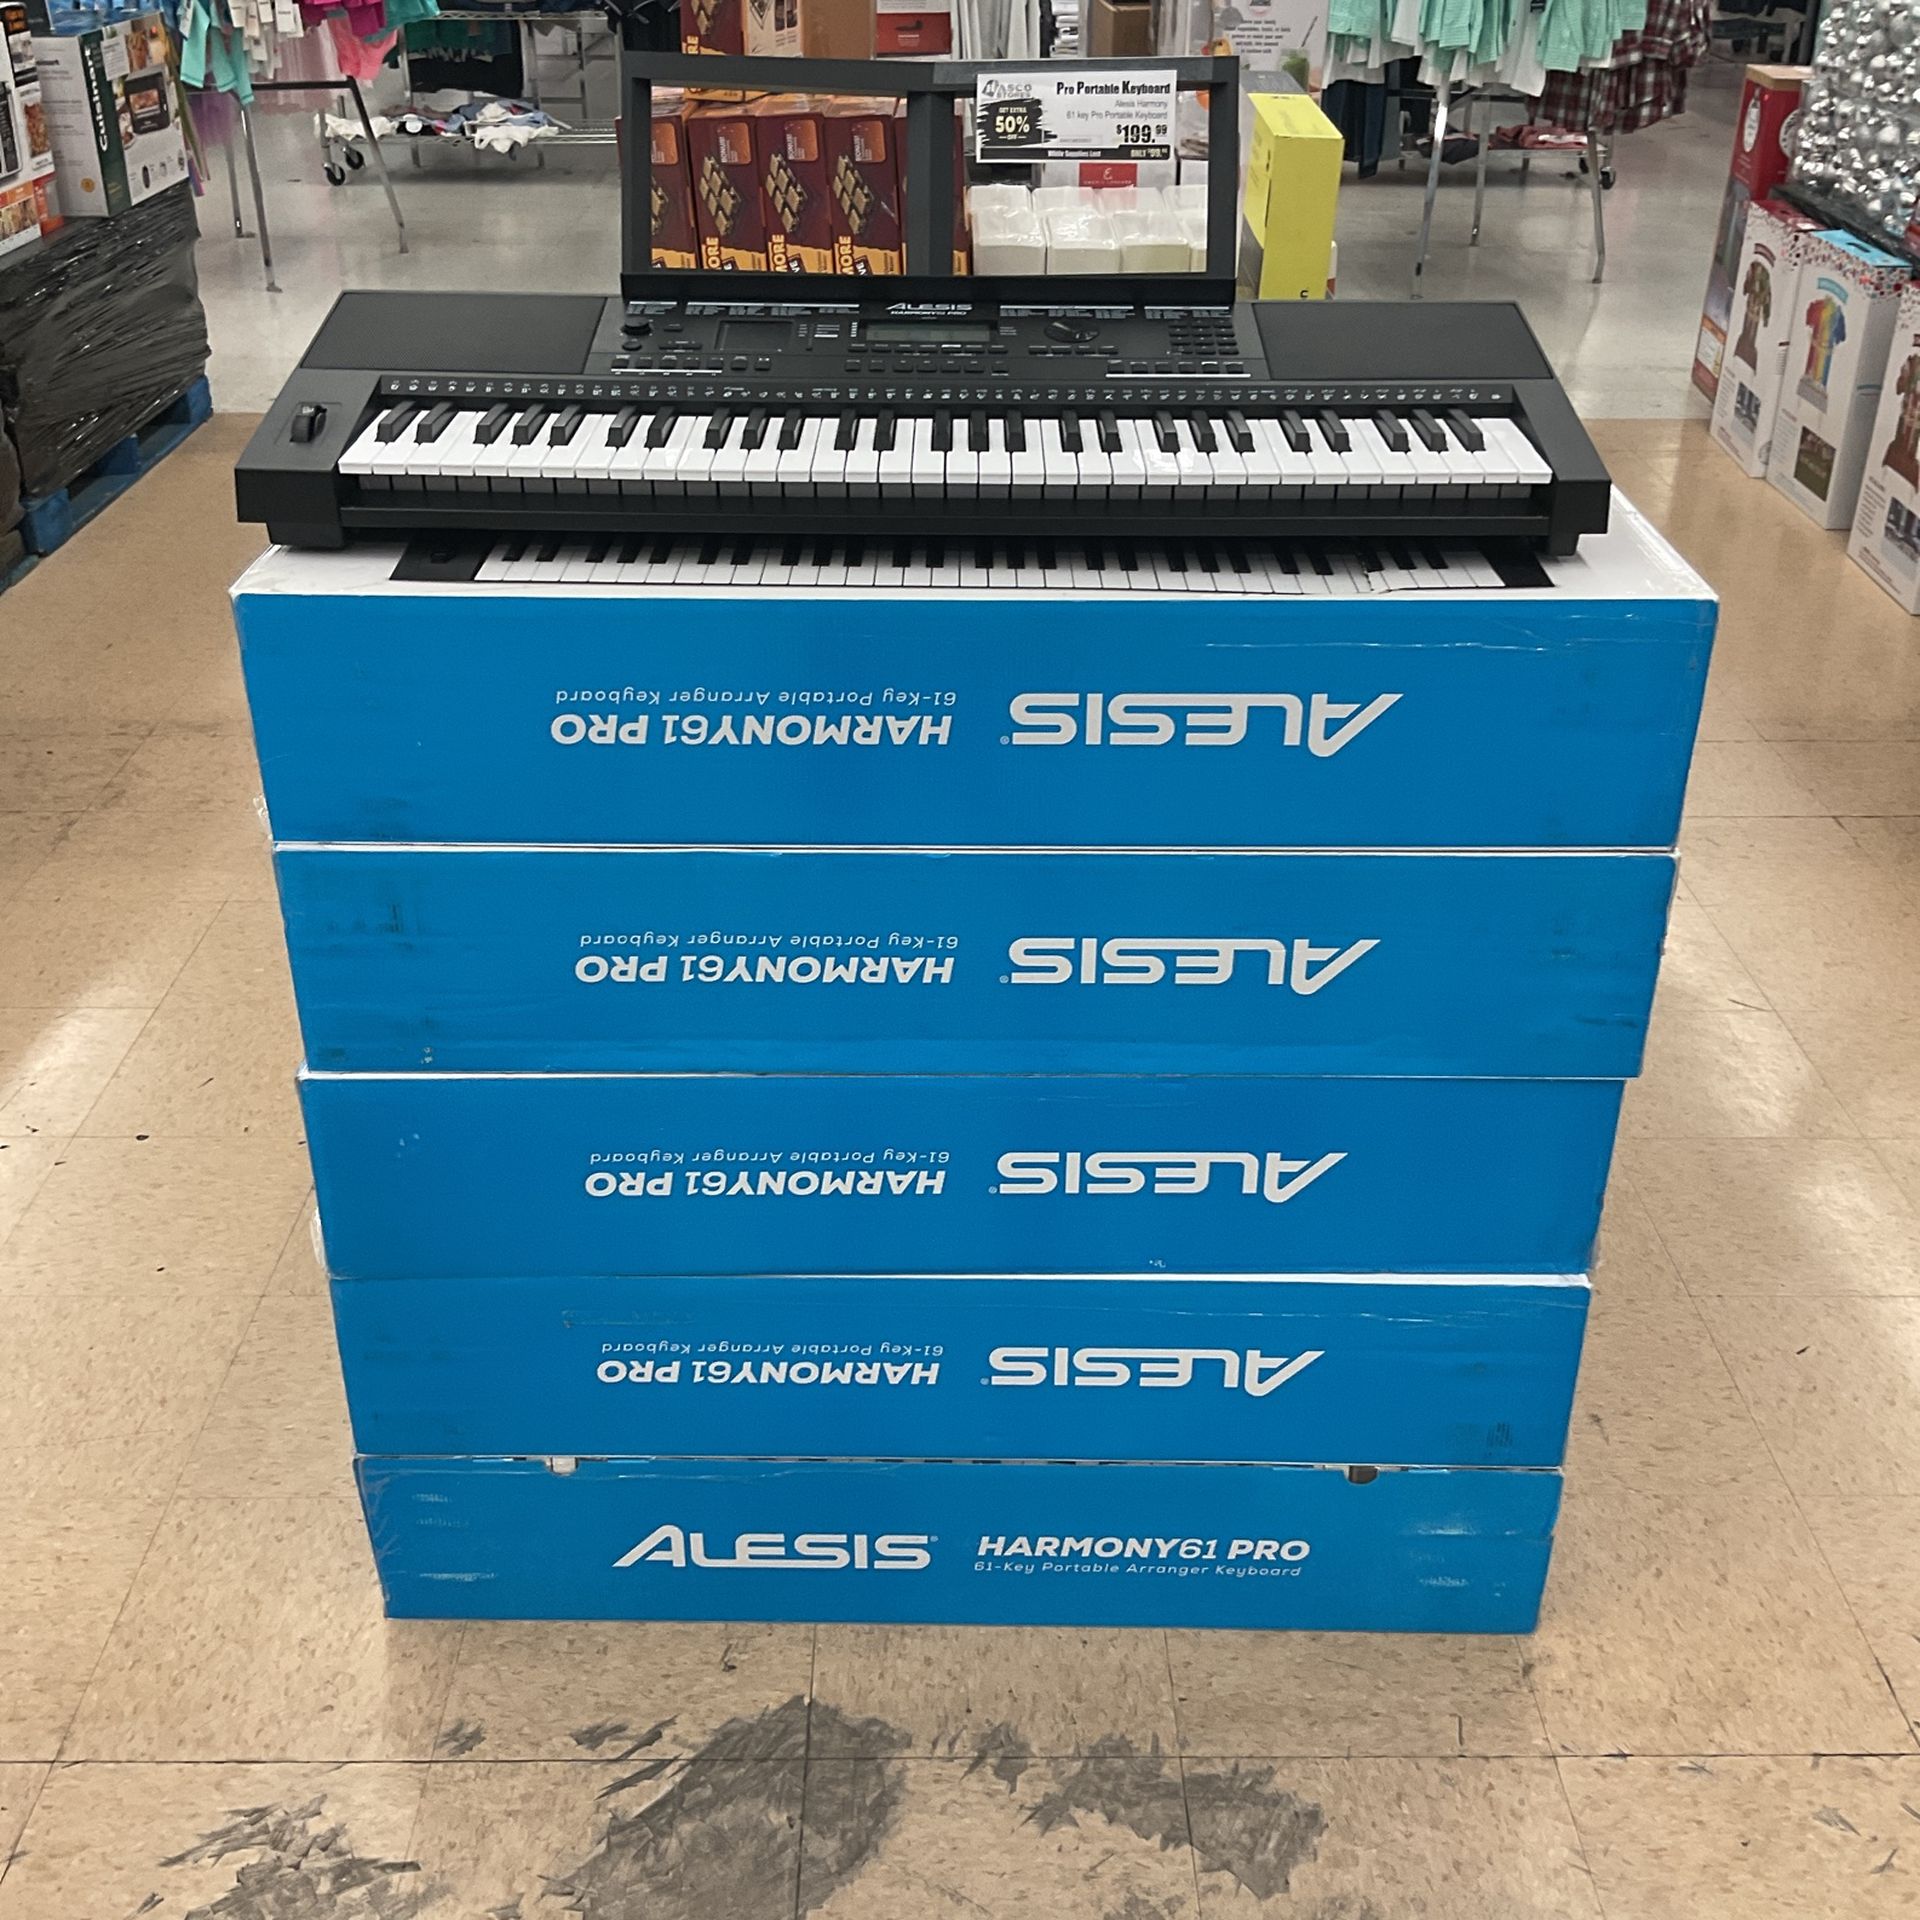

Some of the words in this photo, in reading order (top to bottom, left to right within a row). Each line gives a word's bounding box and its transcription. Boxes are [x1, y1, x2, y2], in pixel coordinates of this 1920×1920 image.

[1056, 82, 1075, 95] Pro
[1077, 81, 1120, 95] Portable
[1122, 80, 1170, 95] Keyboard
[84, 46, 108, 152] Cuisinart
[1115, 100, 1135, 108] Alesis
[1137, 100, 1168, 109] Harmony
[995, 115, 1030, 133] 50%
[1066, 111, 1075, 119] 61
[1077, 110, 1089, 121] key
[1091, 111, 1103, 119] Pro
[1105, 110, 1133, 119] Portable
[1135, 110, 1168, 120] Keyboard
[886, 303, 973, 311] ALESIS
[556, 687, 660, 705] Keyboard
[669, 687, 770, 705] Arranger
[780, 689, 872, 705] Portable
[884, 689, 957, 706] 61-Key
[551, 714, 649, 745] PRO
[663, 715, 952, 745] HARMONY61
[1010, 693, 1403, 757] ALESIS
[580, 932, 679, 947] Keyboard
[687, 932, 782, 948] Arranger
[790, 935, 879, 949] Portable
[888, 933, 958, 949] 61-Key
[575, 956, 667, 983] PRO
[681, 956, 955, 983] HARMONY61
[1005, 938, 1381, 995] ALESIS
[590, 1149, 684, 1164] Keyboard
[692, 1149, 783, 1163] Arranger
[790, 1151, 875, 1163] Portable
[884, 1149, 950, 1164] 61-Key
[585, 1171, 673, 1197] PRO
[686, 1171, 946, 1196] HARMONY61
[997, 1152, 1348, 1203] ALESIS
[602, 1341, 690, 1354] Keyboard
[698, 1341, 783, 1355] Arranger
[791, 1343, 873, 1356] Portable
[880, 1341, 944, 1356] 61-Key
[597, 1360, 681, 1383] PRO
[692, 1361, 940, 1385] HARMONY61
[988, 1347, 1325, 1397] ALESIS
[611, 1524, 932, 1570] ALESIS
[977, 1536, 1217, 1559] HARMONY61
[1227, 1539, 1311, 1561] PRO
[974, 1561, 1035, 1574] 61-Key
[1042, 1562, 1120, 1573] Portable
[1126, 1563, 1209, 1577] Arranger
[1215, 1564, 1302, 1578] Keyboard
